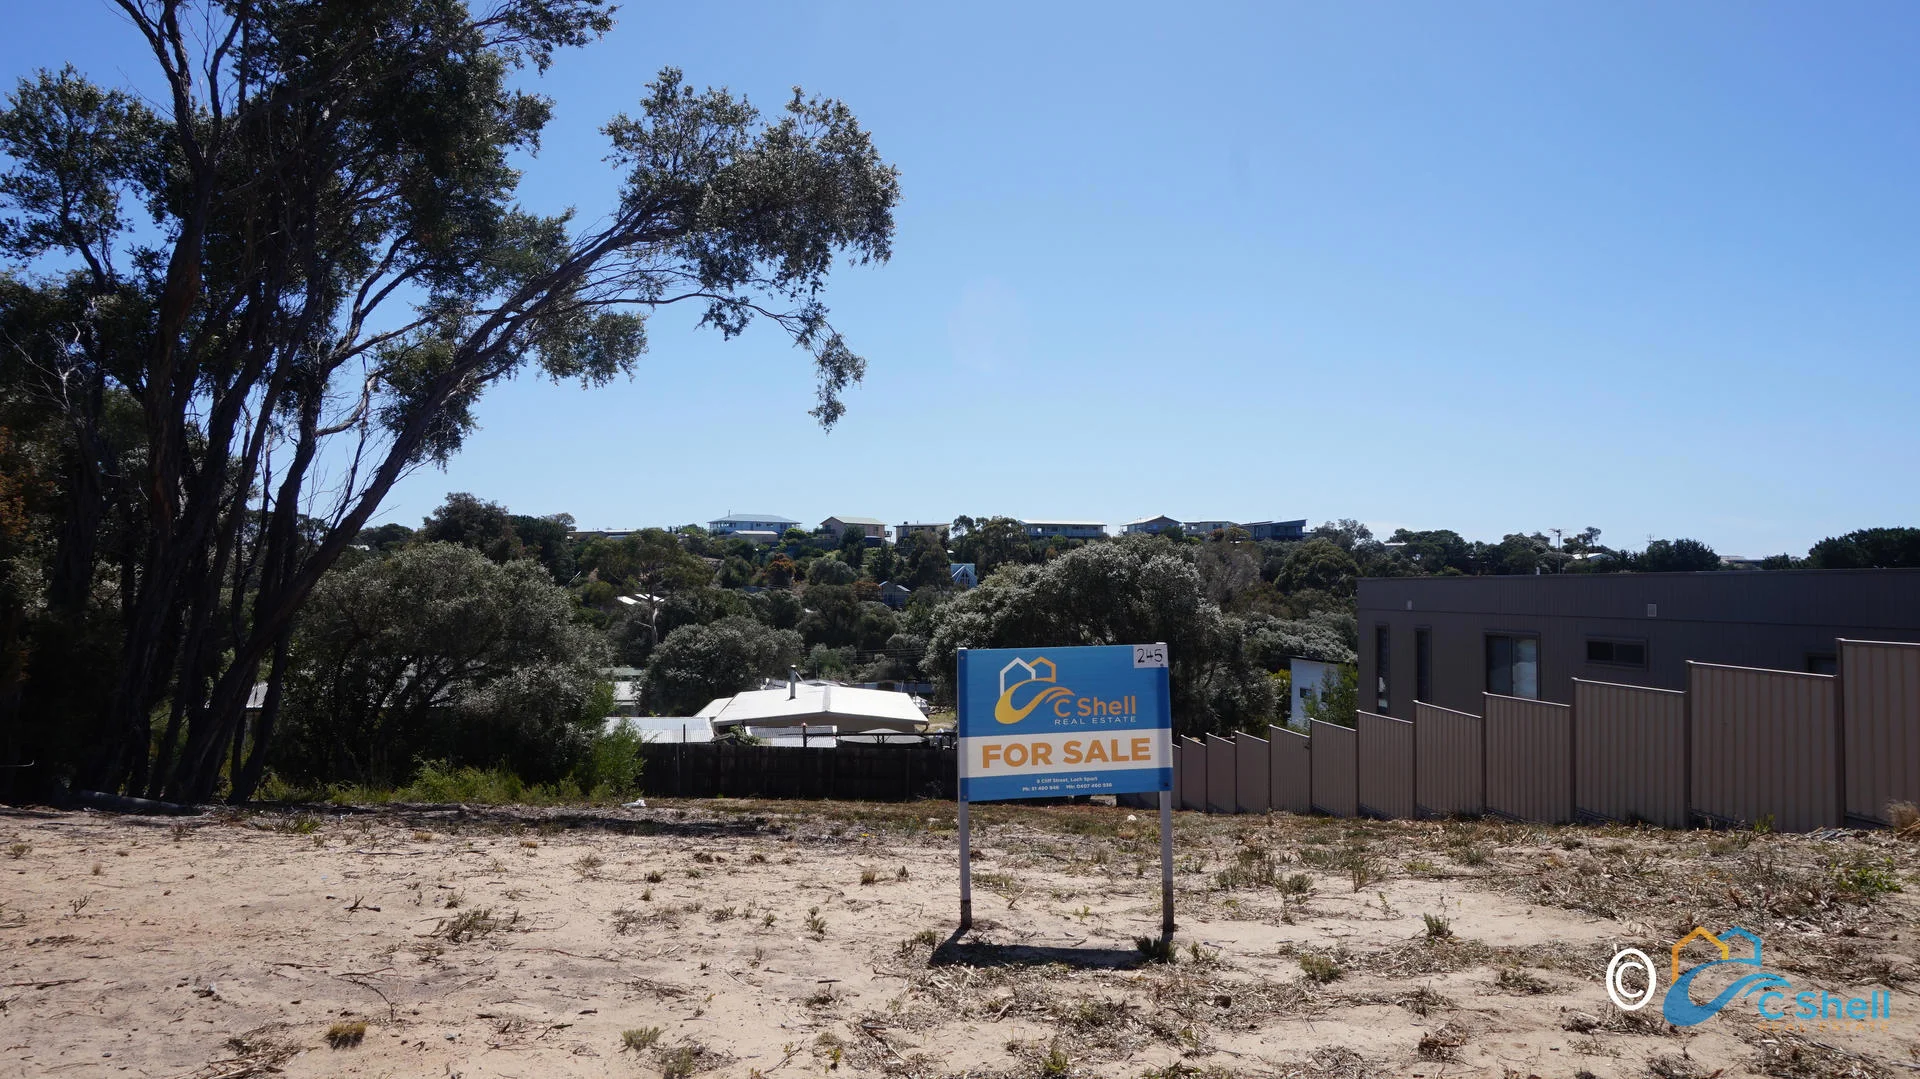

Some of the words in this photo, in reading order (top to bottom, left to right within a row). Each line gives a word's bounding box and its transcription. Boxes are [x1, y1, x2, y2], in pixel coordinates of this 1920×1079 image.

[1136, 648, 1163, 663] 245
[1053, 698, 1071, 717] C
[1077, 695, 1136, 716] Shell
[1091, 715, 1137, 724] ESTATE
[982, 742, 1053, 768] FOR
[1063, 737, 1151, 764] SALE
